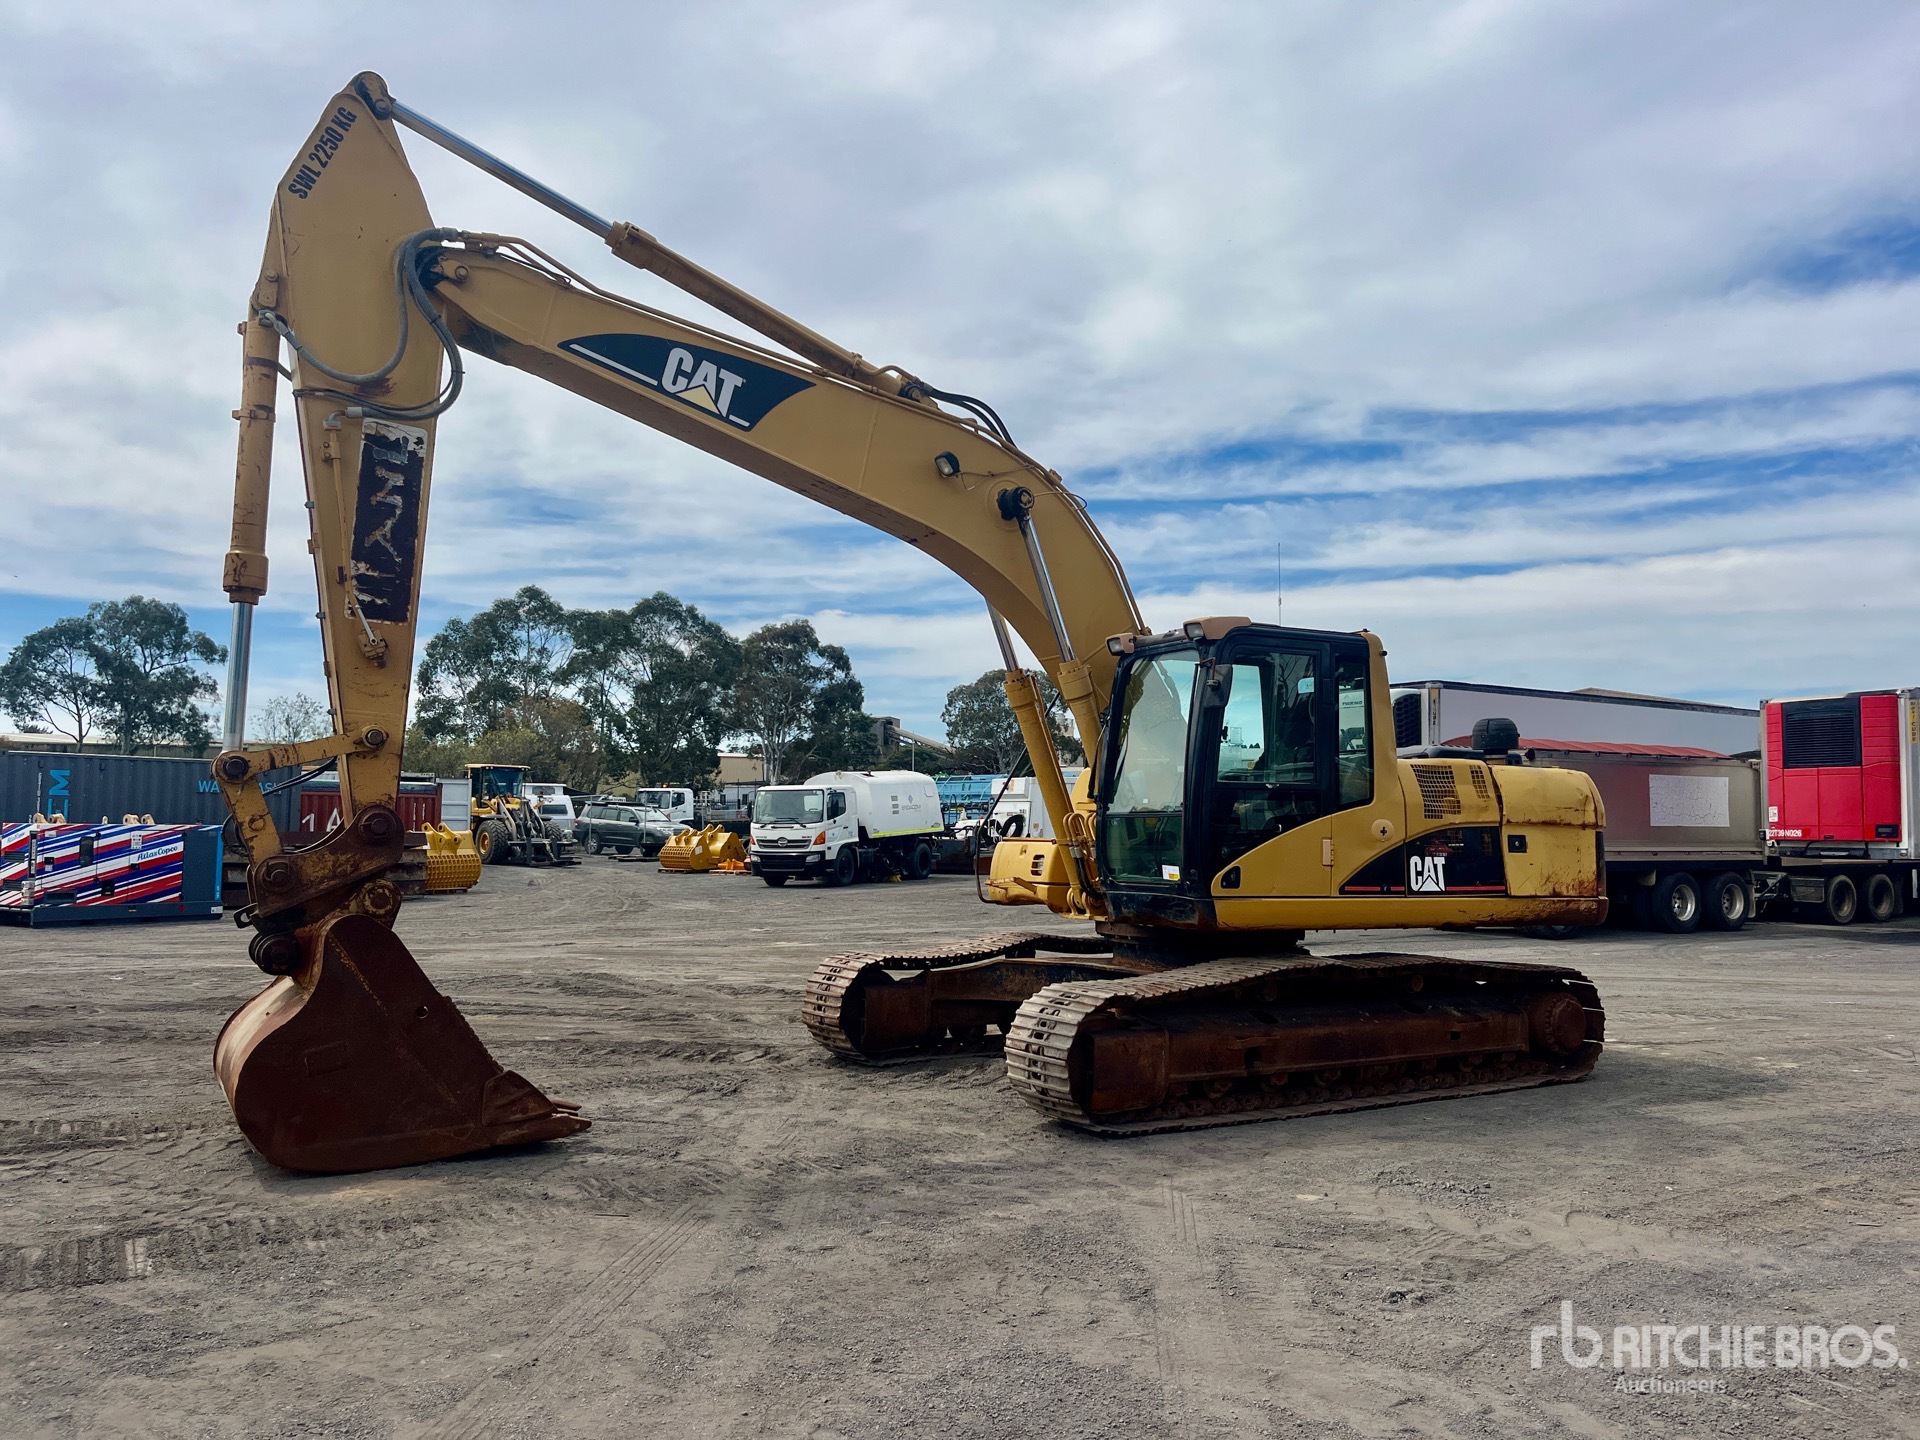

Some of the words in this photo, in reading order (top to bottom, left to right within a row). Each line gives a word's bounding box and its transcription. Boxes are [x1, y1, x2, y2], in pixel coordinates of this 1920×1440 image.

[288, 163, 322, 200] SWL
[308, 125, 345, 169] 2250
[330, 106, 358, 132] KG
[661, 347, 743, 418] CAT
[1410, 855, 1446, 891] CAT
